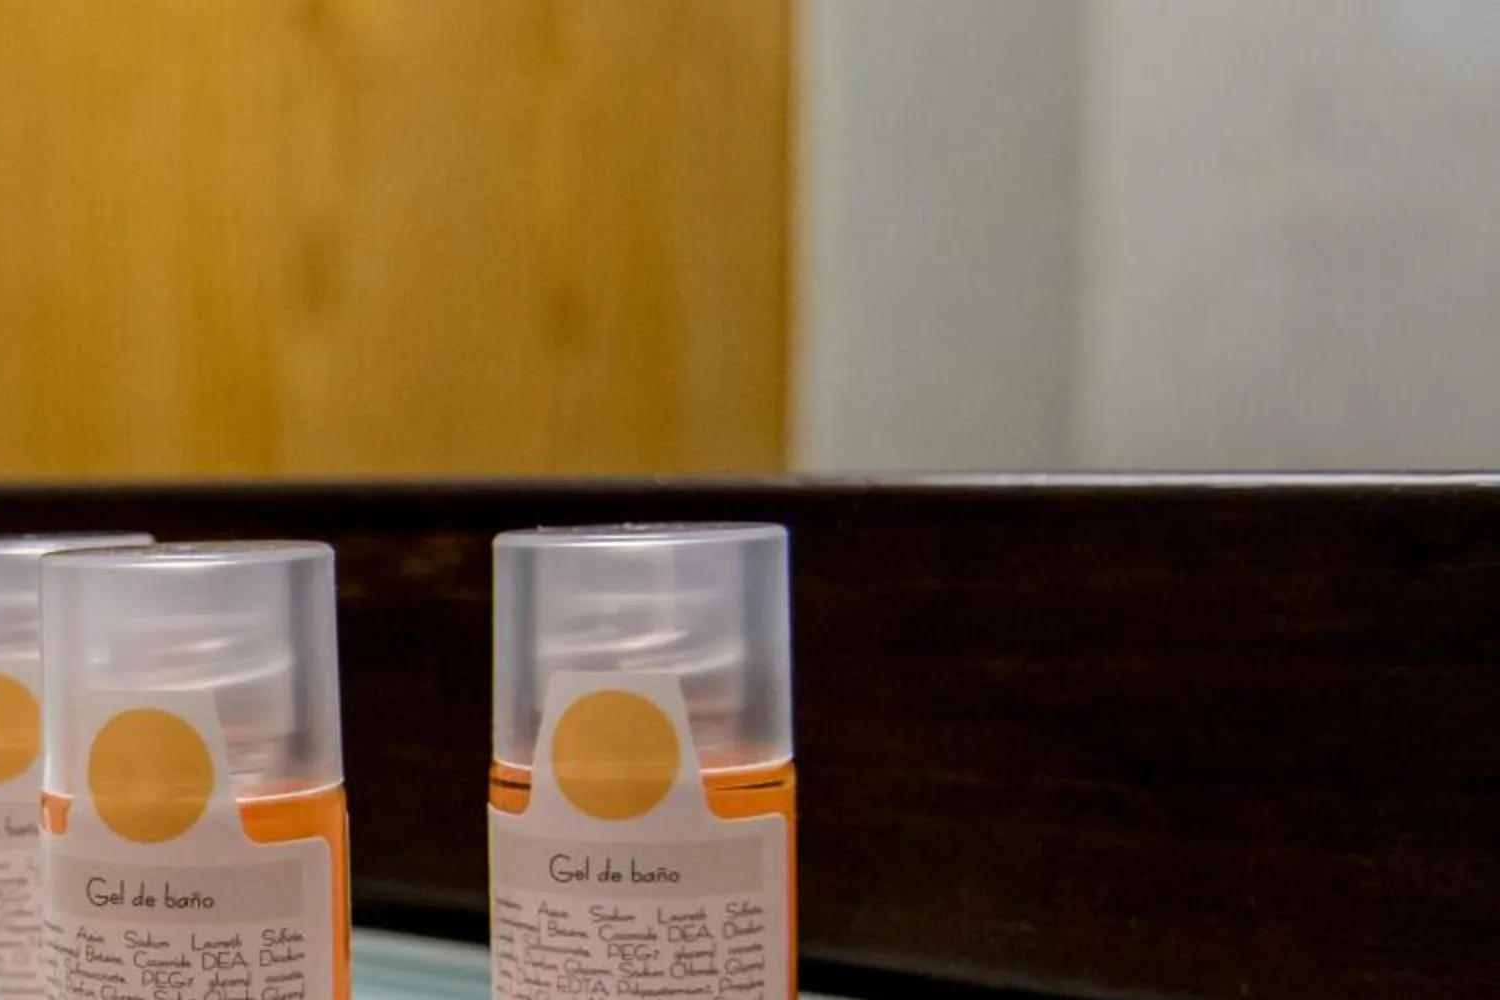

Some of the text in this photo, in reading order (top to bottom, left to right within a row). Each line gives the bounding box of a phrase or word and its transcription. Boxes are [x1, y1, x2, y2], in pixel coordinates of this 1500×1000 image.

[549, 853, 681, 883] Gel de baño
[86, 877, 215, 909] Gel de baño
